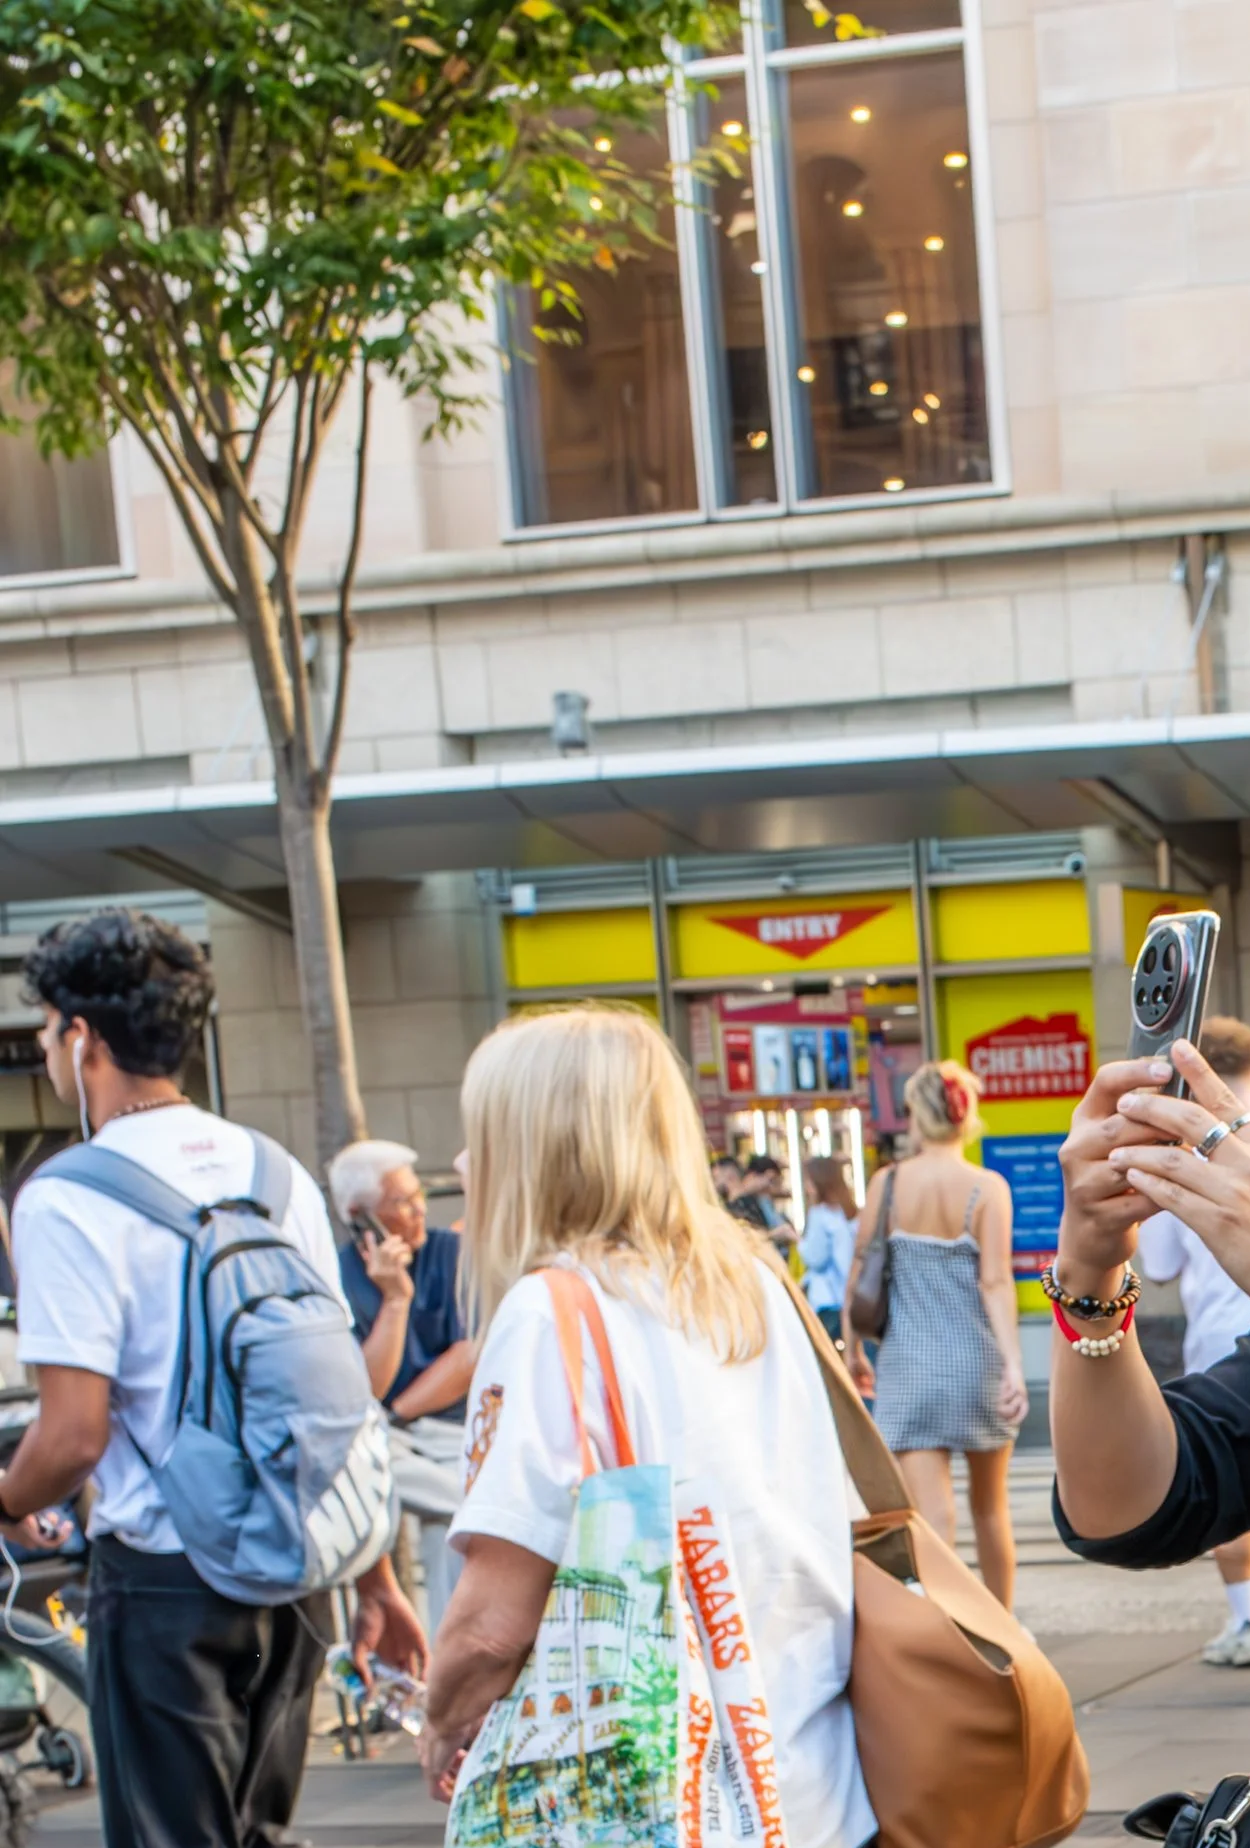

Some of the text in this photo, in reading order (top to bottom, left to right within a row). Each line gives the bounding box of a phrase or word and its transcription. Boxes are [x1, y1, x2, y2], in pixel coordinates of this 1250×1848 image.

[758, 913, 842, 944] ENTRY
[971, 1042, 1088, 1076] CHEMIST
[677, 1505, 752, 1672] ZABARS
